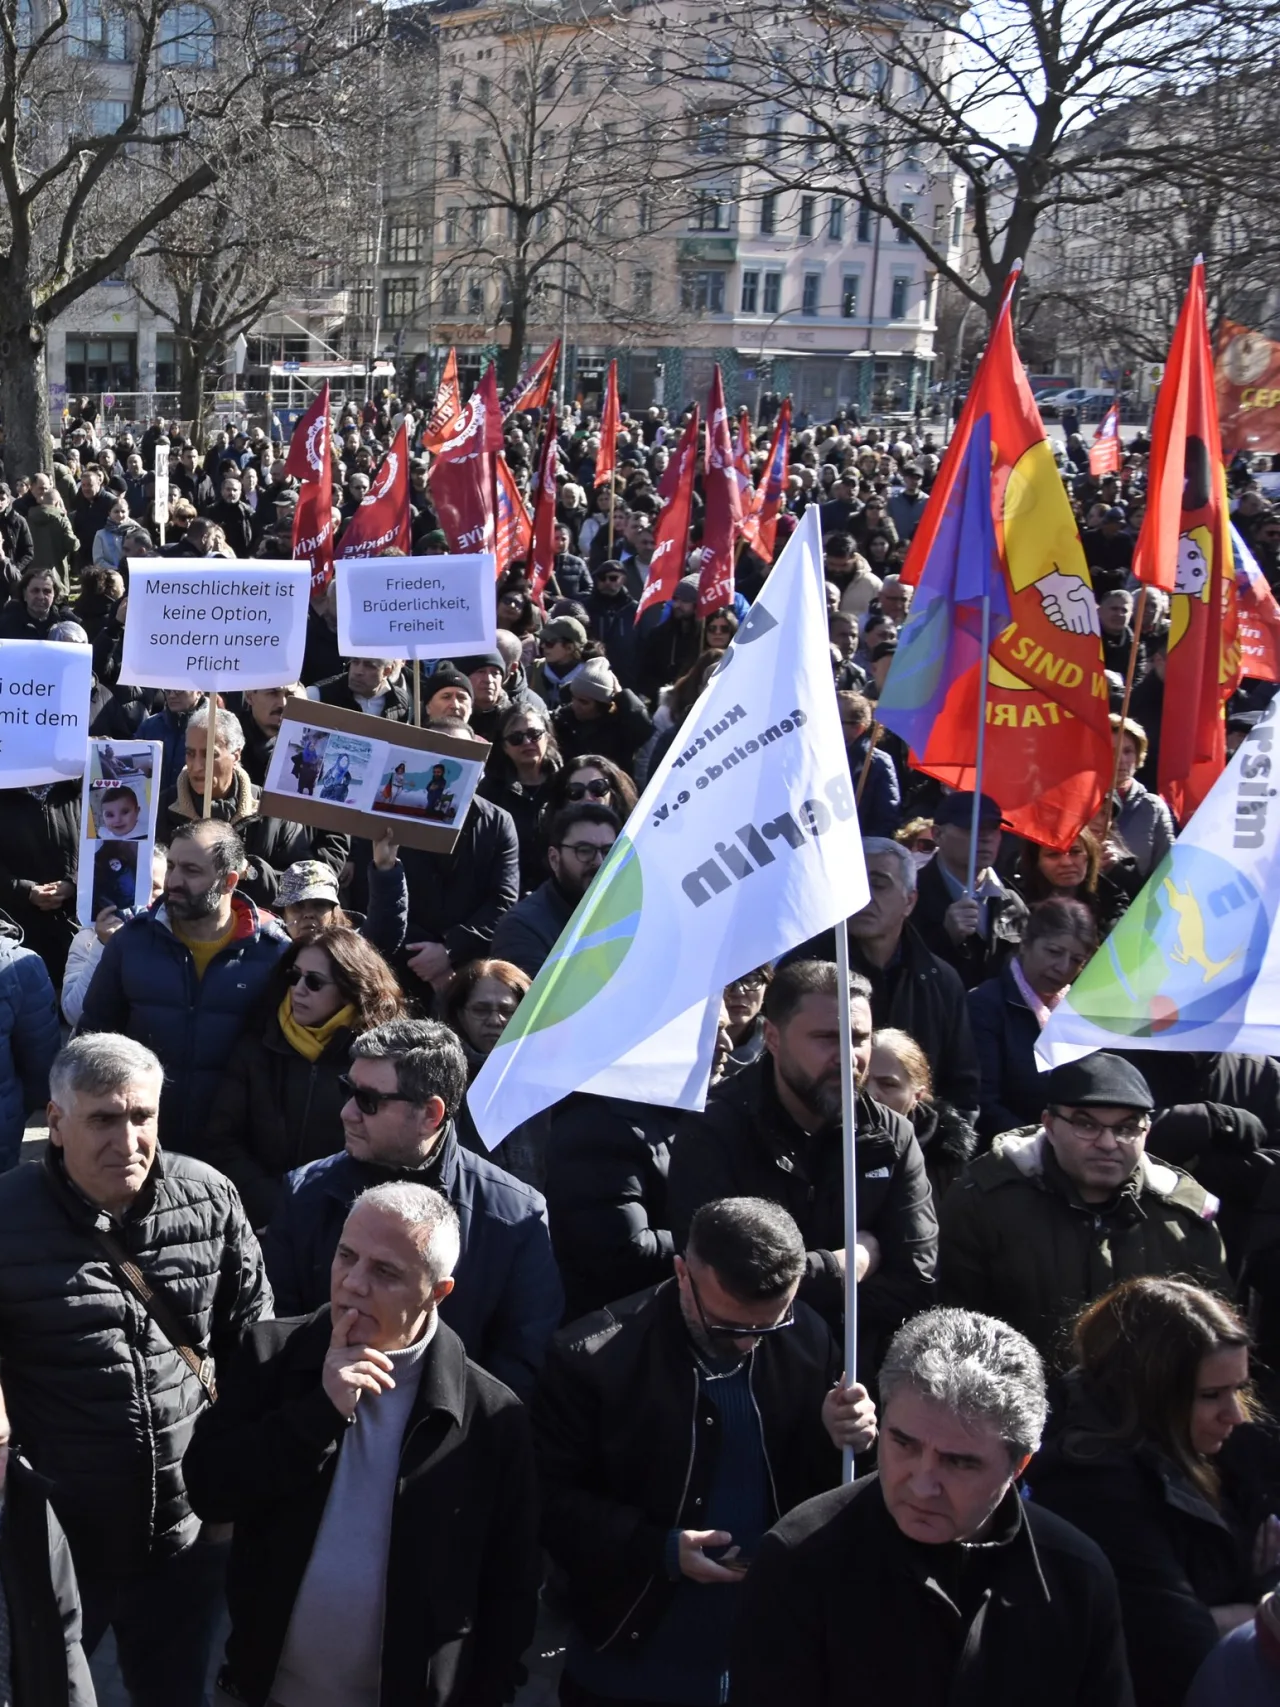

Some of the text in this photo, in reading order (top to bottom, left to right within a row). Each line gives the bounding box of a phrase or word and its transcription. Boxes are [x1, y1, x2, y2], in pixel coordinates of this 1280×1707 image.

[145, 579, 295, 597] Menschlichkeit ist
[386, 577, 445, 591] Frieden,
[363, 596, 470, 613] Brüderlichkeit,
[162, 605, 272, 625] keine Option,
[389, 618, 445, 632] Freiheit
[149, 630, 280, 647] sondern unsere
[186, 655, 240, 671] Pflicht
[1010, 637, 1084, 688] SIND
[9, 679, 56, 697] oder
[35, 709, 78, 727] dem
